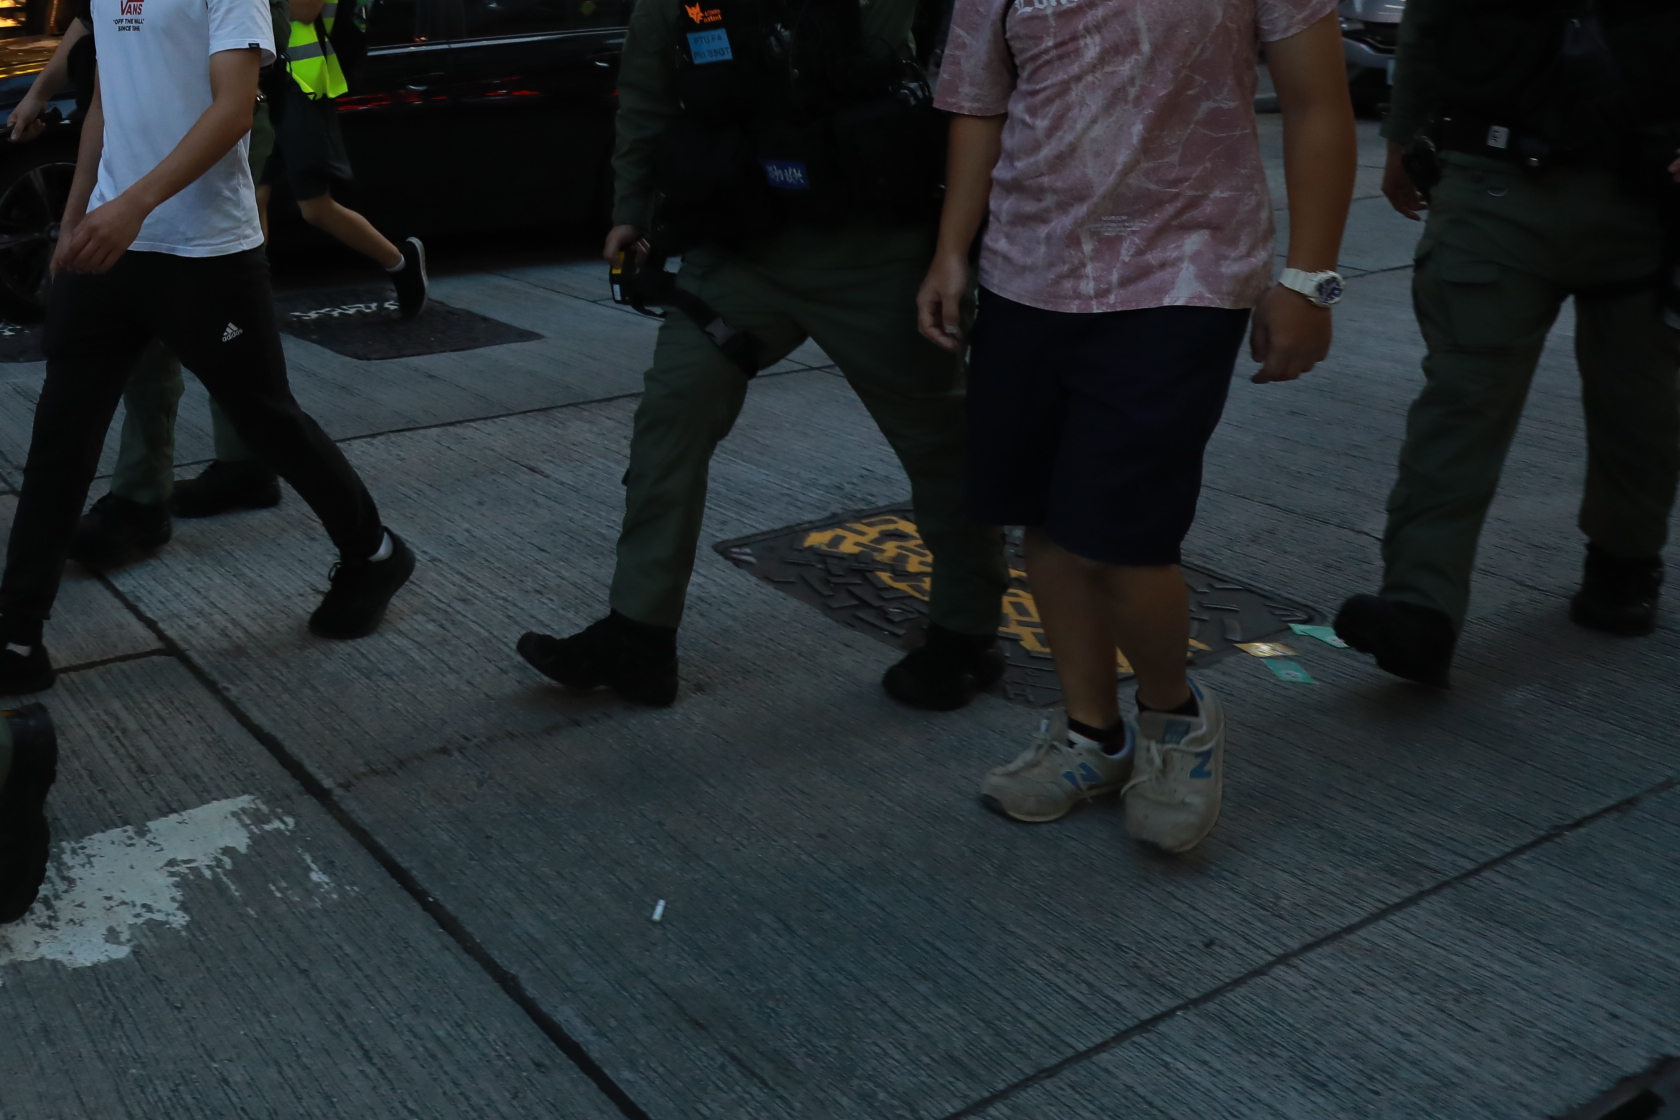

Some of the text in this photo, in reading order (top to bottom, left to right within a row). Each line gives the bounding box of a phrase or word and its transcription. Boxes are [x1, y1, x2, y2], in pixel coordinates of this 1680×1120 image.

[120, 0, 144, 15] VANS
[694, 35, 710, 45] PTU
[708, 46, 730, 58] SSGT
[222, 328, 243, 343] adidas
